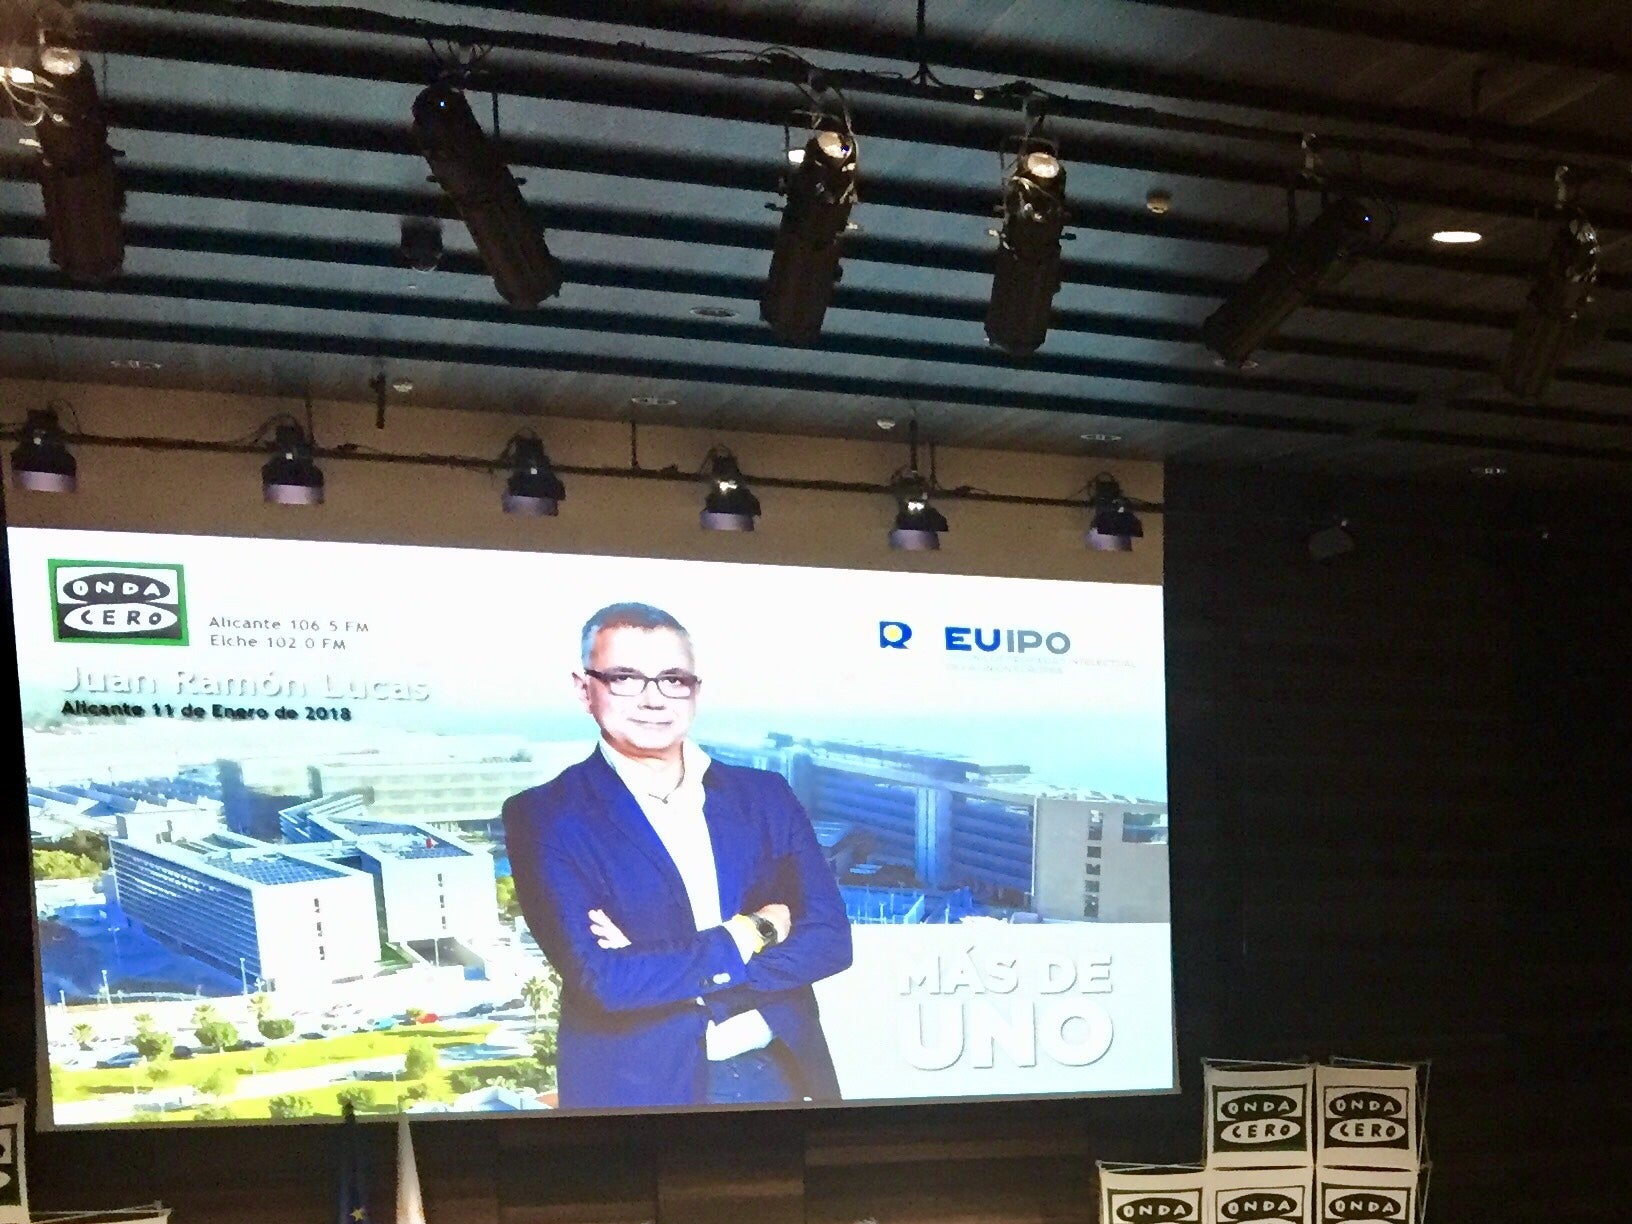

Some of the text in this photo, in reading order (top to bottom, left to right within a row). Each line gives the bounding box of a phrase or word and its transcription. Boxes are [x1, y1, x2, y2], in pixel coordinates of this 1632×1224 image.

[71, 578, 161, 599] ONDA
[80, 609, 164, 627] CERO
[208, 616, 281, 630] Alicante
[345, 621, 369, 633] FM
[210, 634, 258, 648] Elche
[322, 638, 346, 650] FM
[944, 626, 1072, 655] EUIPO
[62, 666, 431, 702] Juan Ramón Lucas
[61, 700, 352, 722] Alicante 11 de Enero de 2018
[899, 946, 1113, 996] MÁS DE
[904, 1002, 1114, 1071] UNO
[1227, 1100, 1290, 1114] ONDA
[1335, 1098, 1395, 1112] ONDA
[1231, 1122, 1291, 1138] CERO
[1339, 1122, 1397, 1138] CERO
[1122, 1203, 1186, 1217] ONDA
[1227, 1199, 1290, 1215] ONDA
[1335, 1200, 1394, 1214] ONDA
